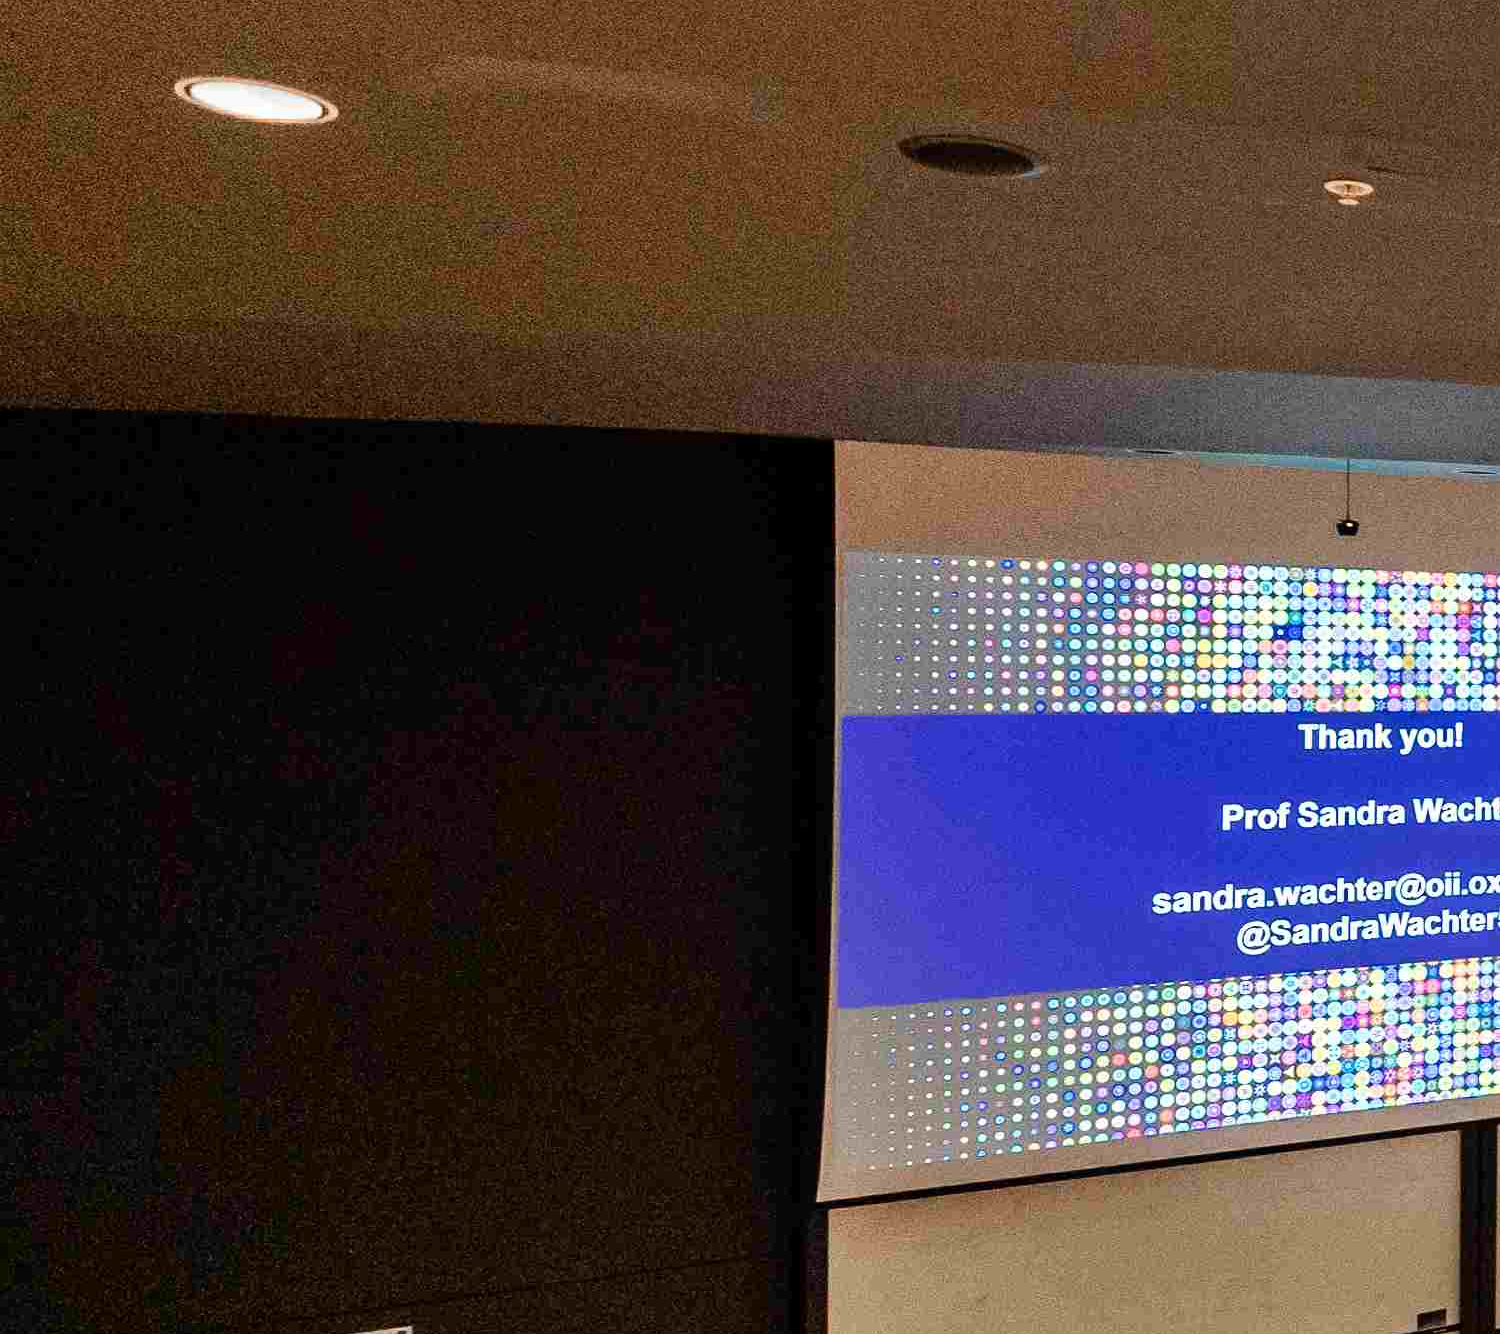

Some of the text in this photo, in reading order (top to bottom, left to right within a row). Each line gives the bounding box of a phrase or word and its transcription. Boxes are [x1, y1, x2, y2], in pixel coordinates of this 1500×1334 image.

[1298, 722, 1464, 755] Thank you!
[1221, 802, 1291, 831] Prof
[1298, 799, 1406, 828] Sandra
